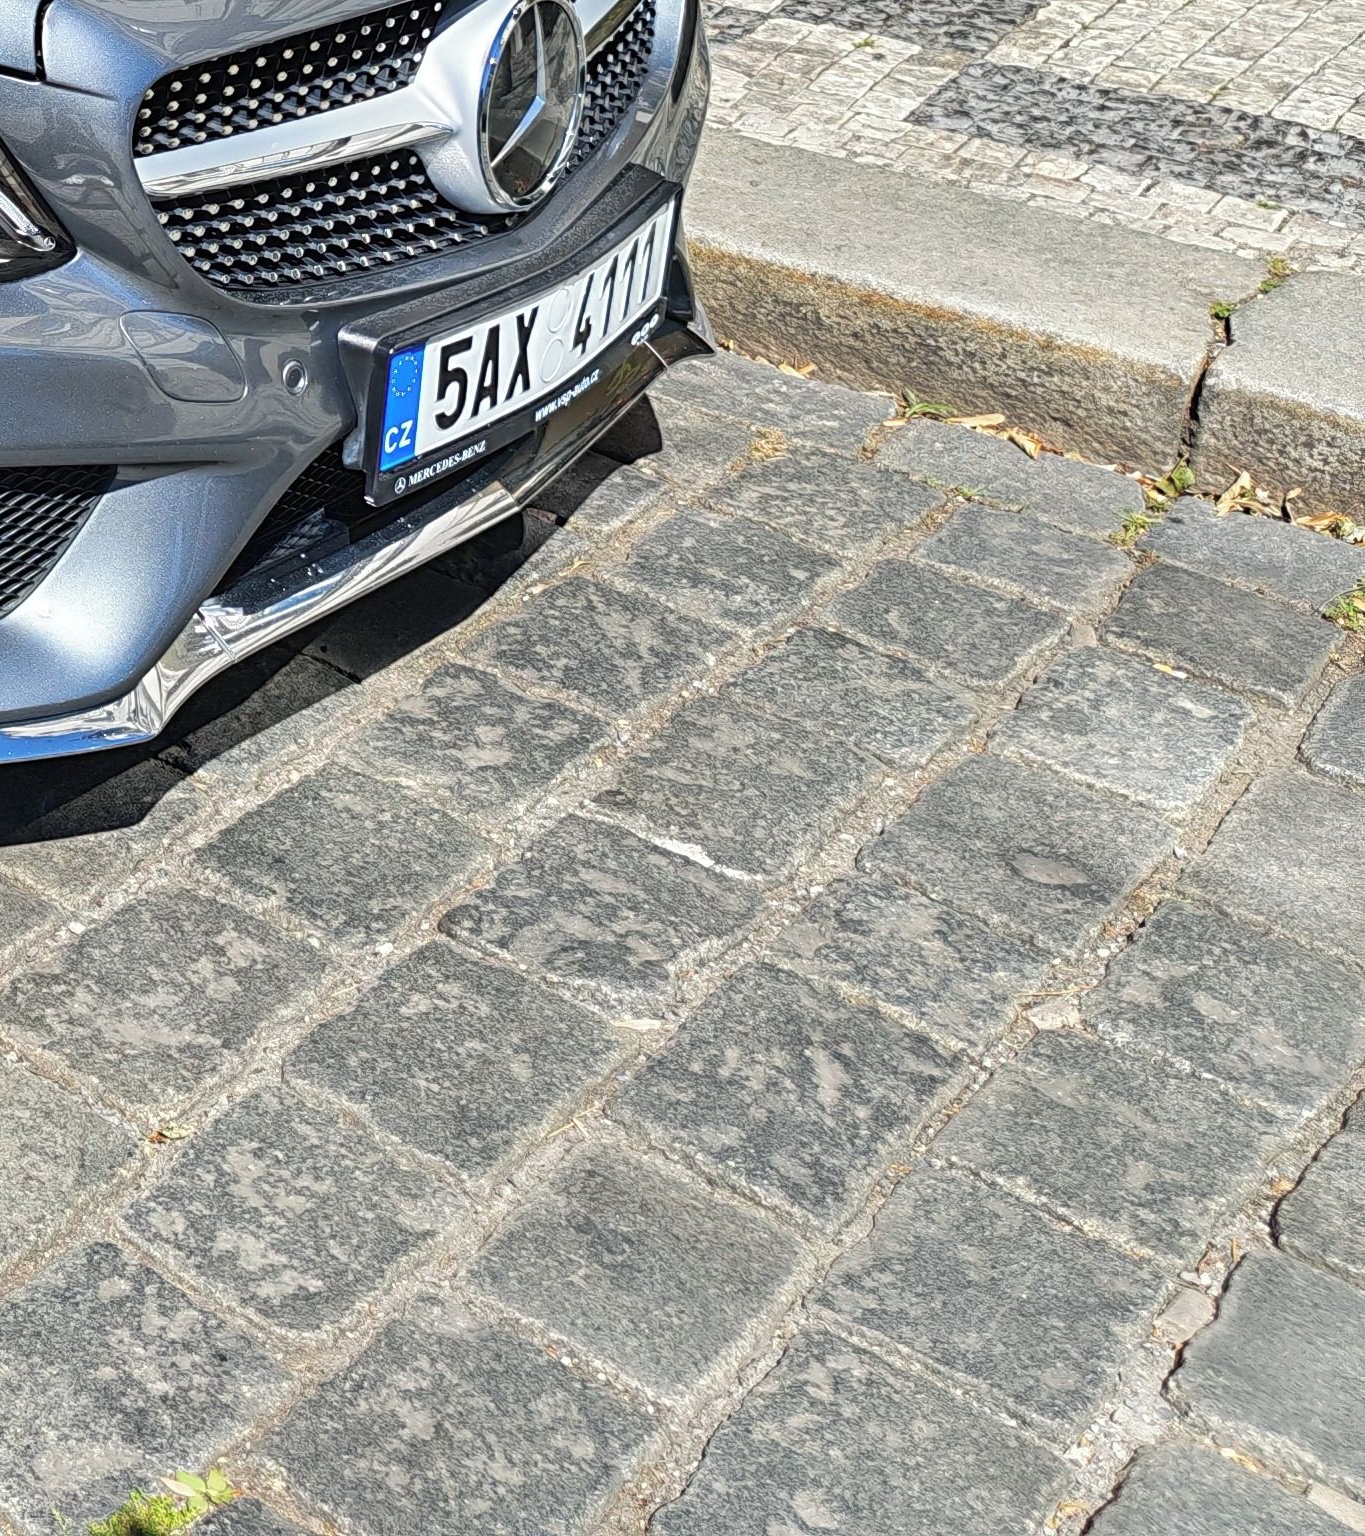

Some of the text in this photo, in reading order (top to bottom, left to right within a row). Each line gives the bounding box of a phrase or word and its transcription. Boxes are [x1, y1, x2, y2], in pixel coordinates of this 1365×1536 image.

[434, 222, 658, 431] 5AX 4111
[384, 419, 413, 454] CZ
[407, 440, 486, 487] MERCEDES-BENZ
